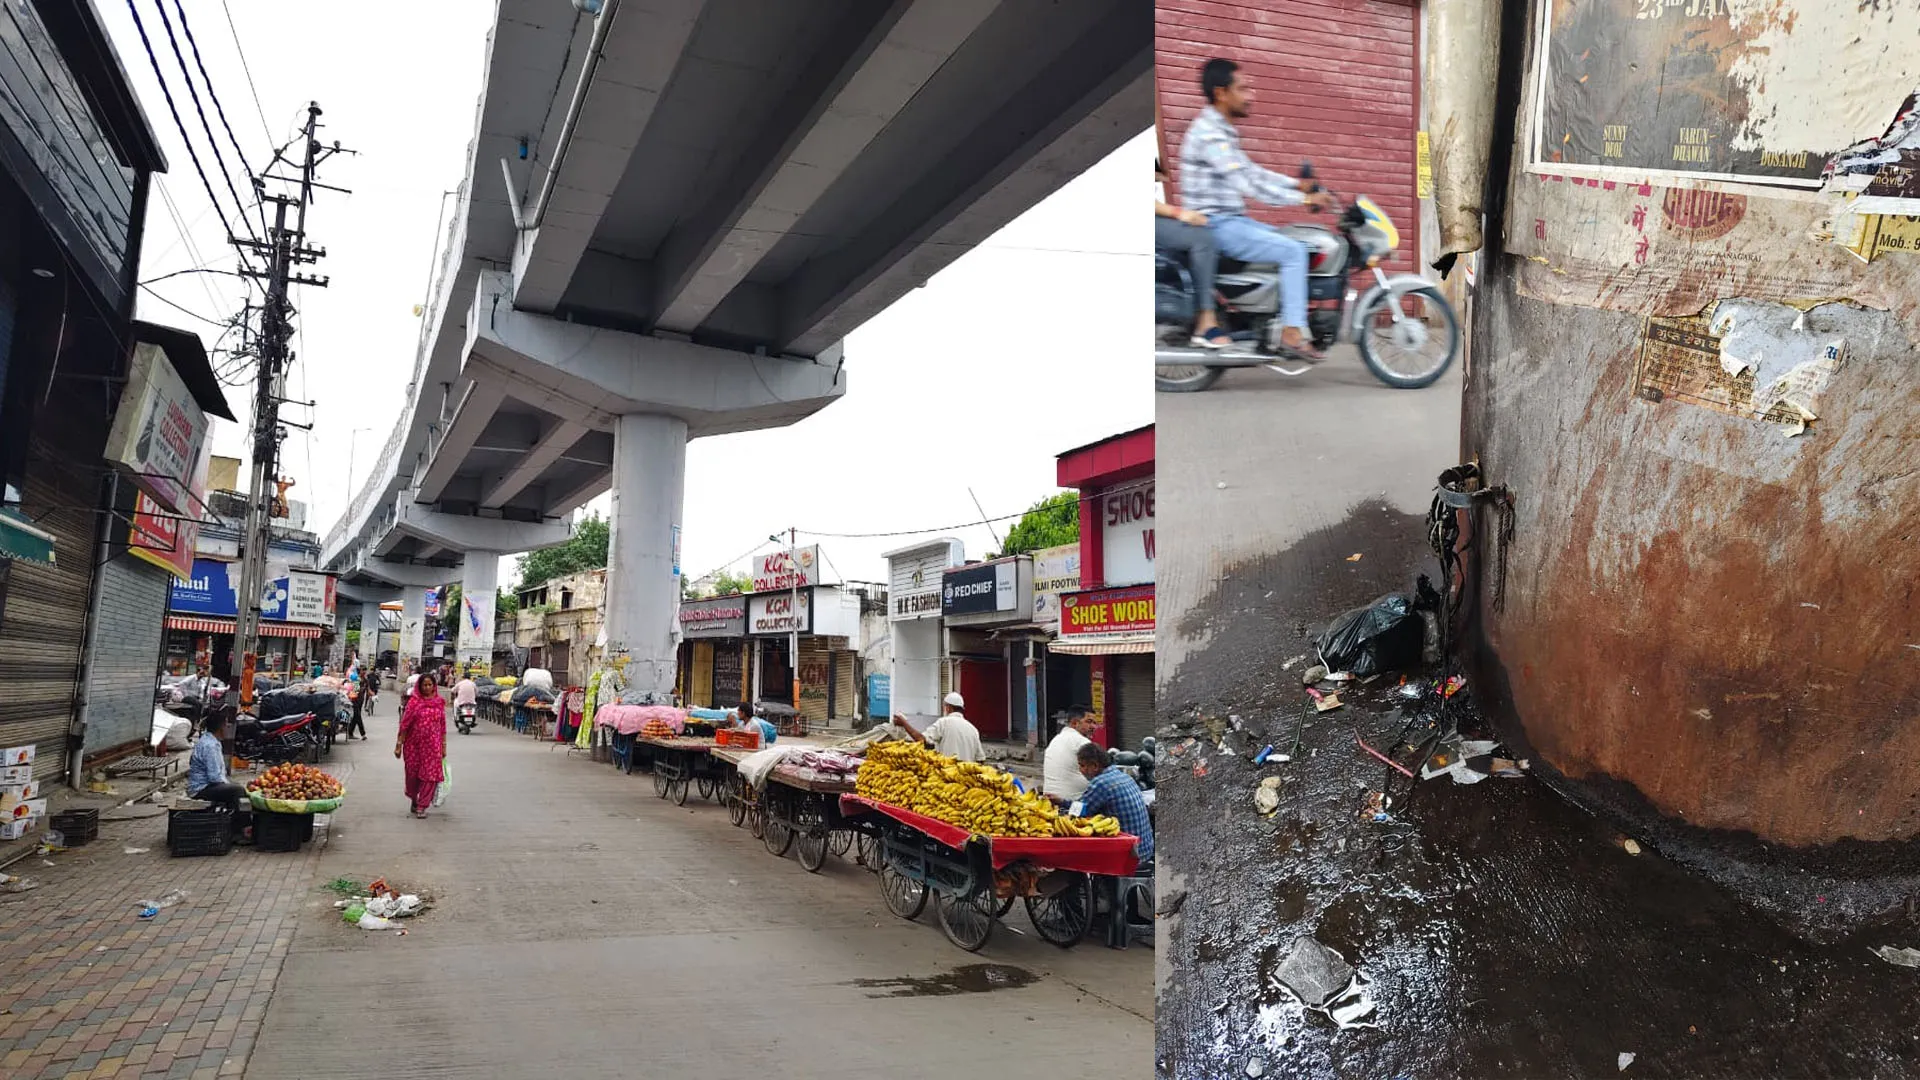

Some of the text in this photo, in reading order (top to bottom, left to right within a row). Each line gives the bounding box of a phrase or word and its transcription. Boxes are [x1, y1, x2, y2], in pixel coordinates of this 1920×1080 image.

[1603, 125, 1628, 141] SUNNY
[1680, 127, 1710, 145] VARUN
[1604, 141, 1623, 158] DEOL
[1672, 144, 1711, 163] DHAWAN
[1760, 150, 1808, 169] DOSANJH
[1879, 234, 1909, 249] Mob.:
[1108, 488, 1155, 526] SHOE
[955, 586, 971, 597] RED
[971, 580, 993, 595] CHIEF
[1071, 603, 1108, 625] SHOE
